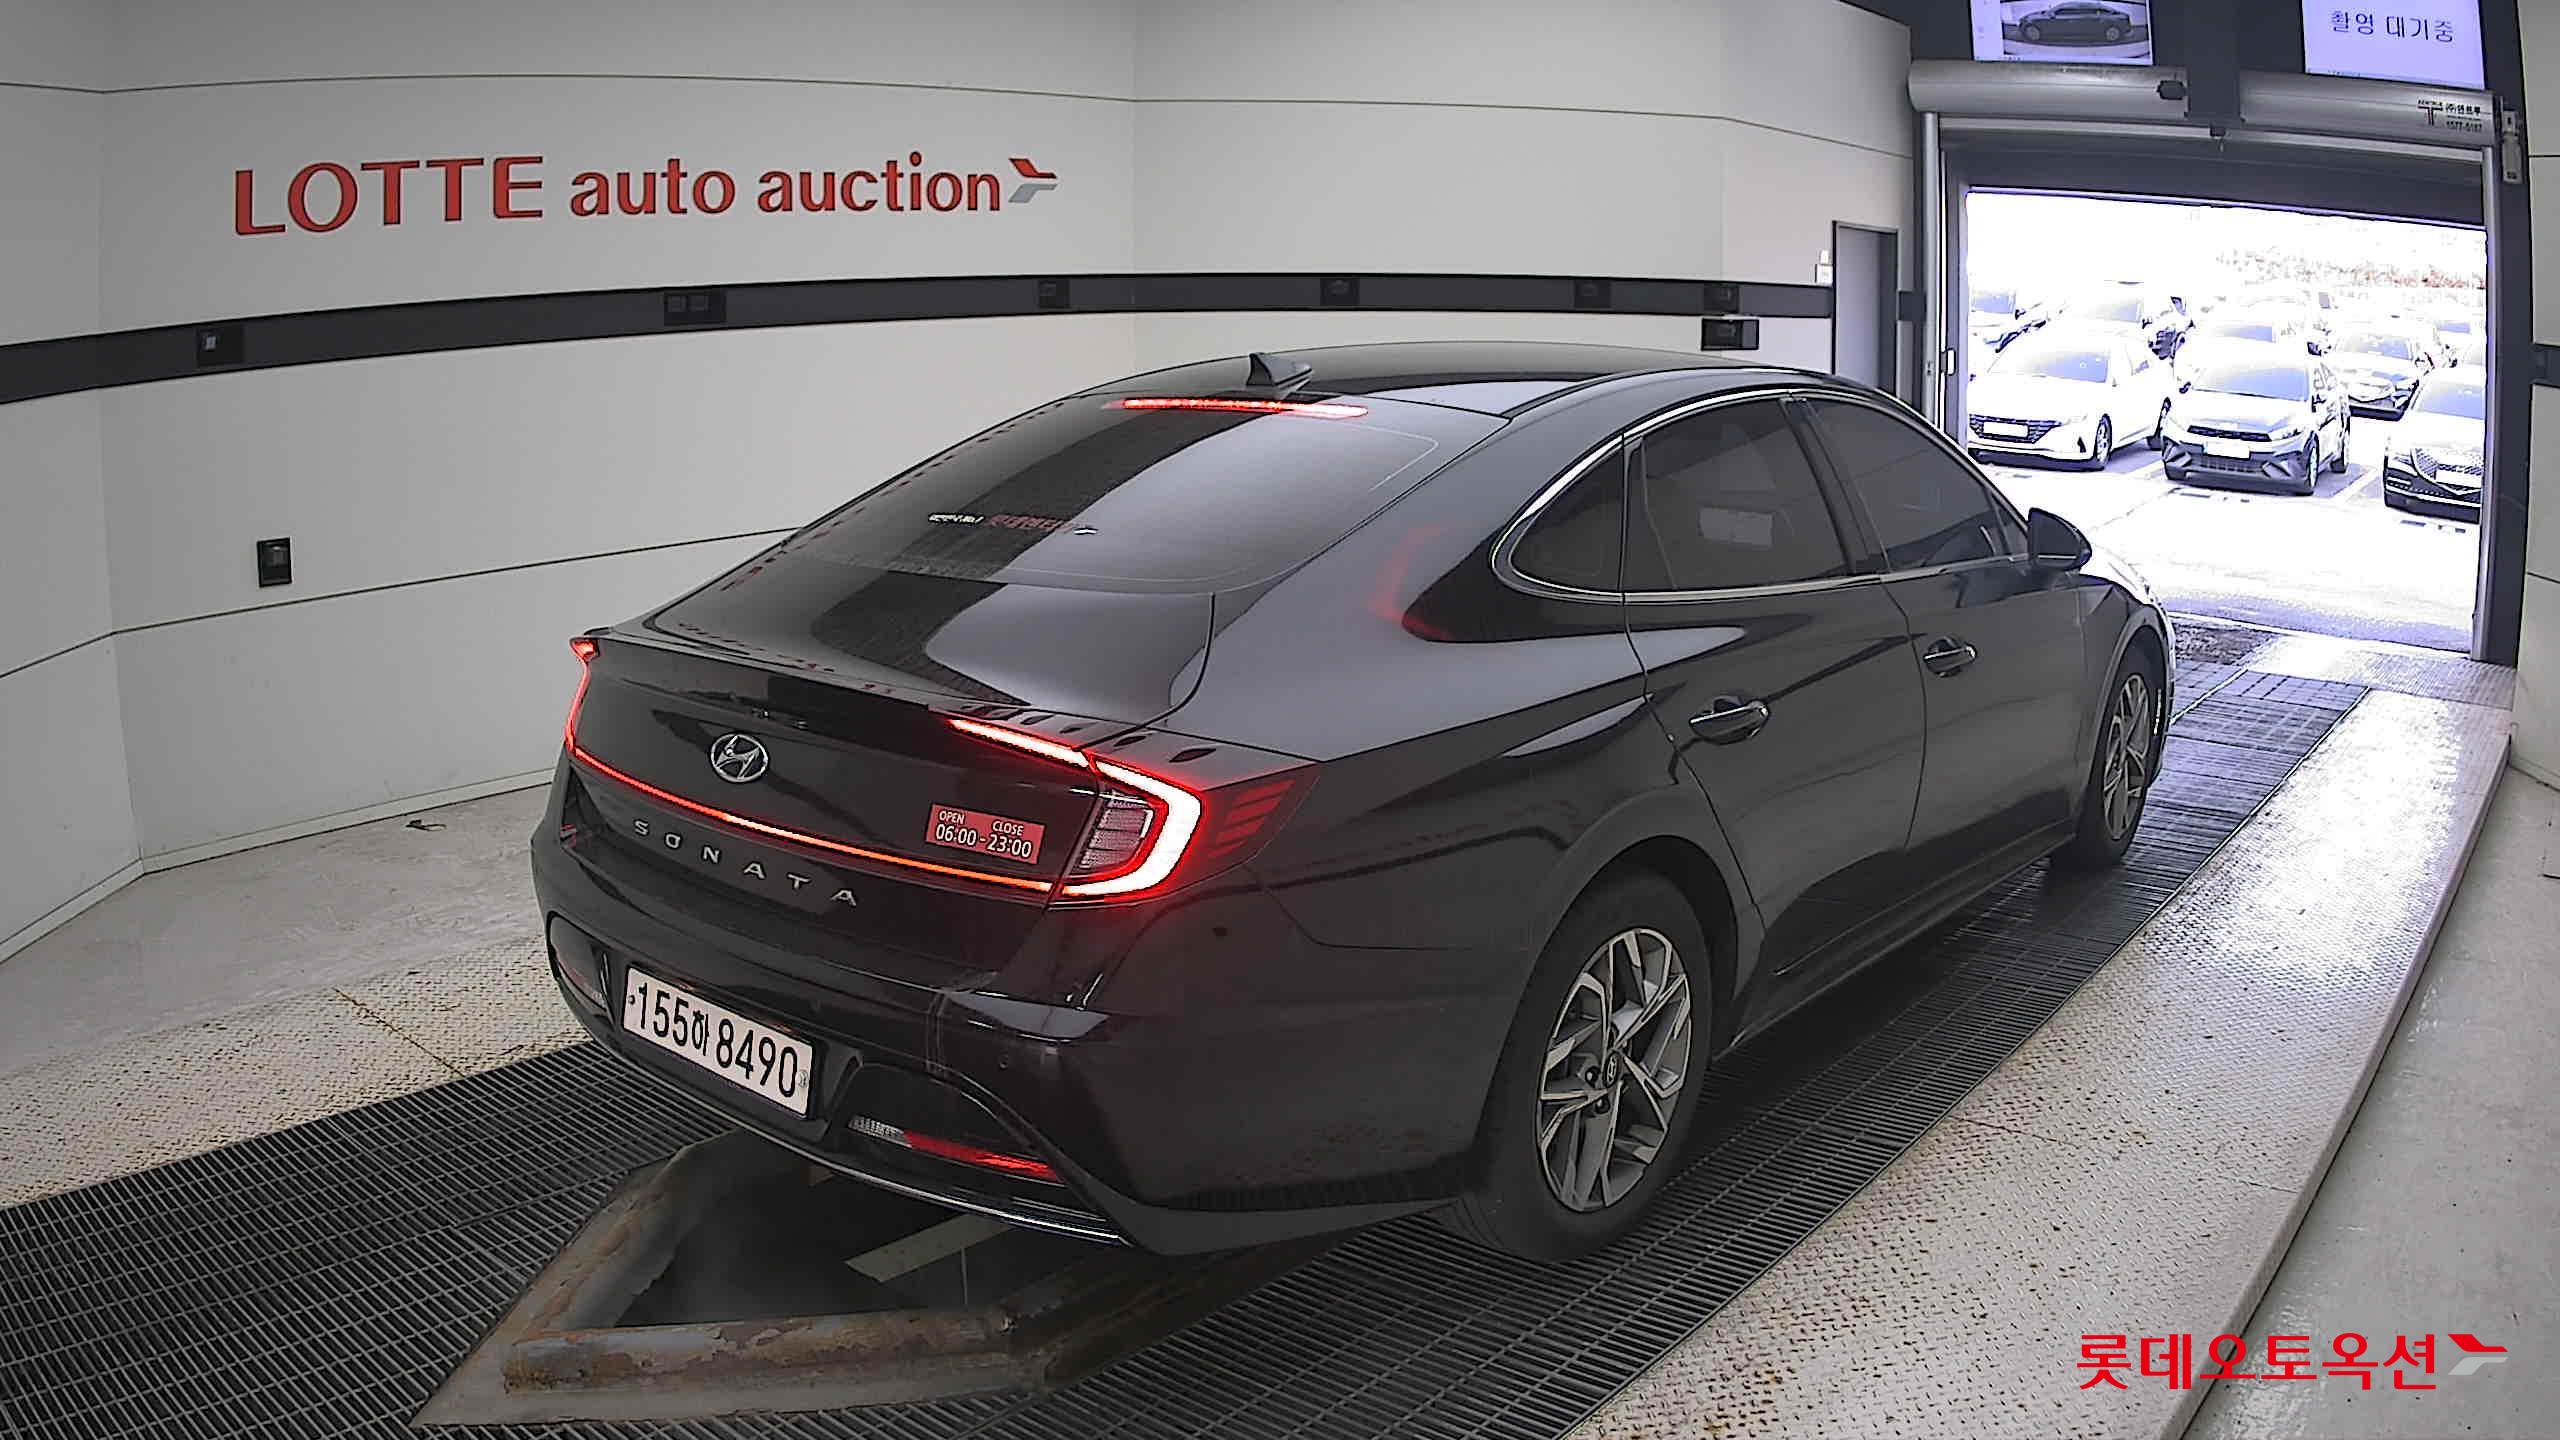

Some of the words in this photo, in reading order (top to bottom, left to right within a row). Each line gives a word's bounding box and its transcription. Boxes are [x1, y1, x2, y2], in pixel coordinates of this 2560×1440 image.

[2331, 10, 2374, 35] 촬영
[2386, 16, 2453, 43] 대기중
[236, 156, 543, 235] LOTTE
[570, 158, 735, 216] auto
[757, 151, 1000, 212] auction
[939, 810, 965, 825] OPEN
[992, 821, 1024, 836] CLOSE
[634, 819, 857, 906] SONATA
